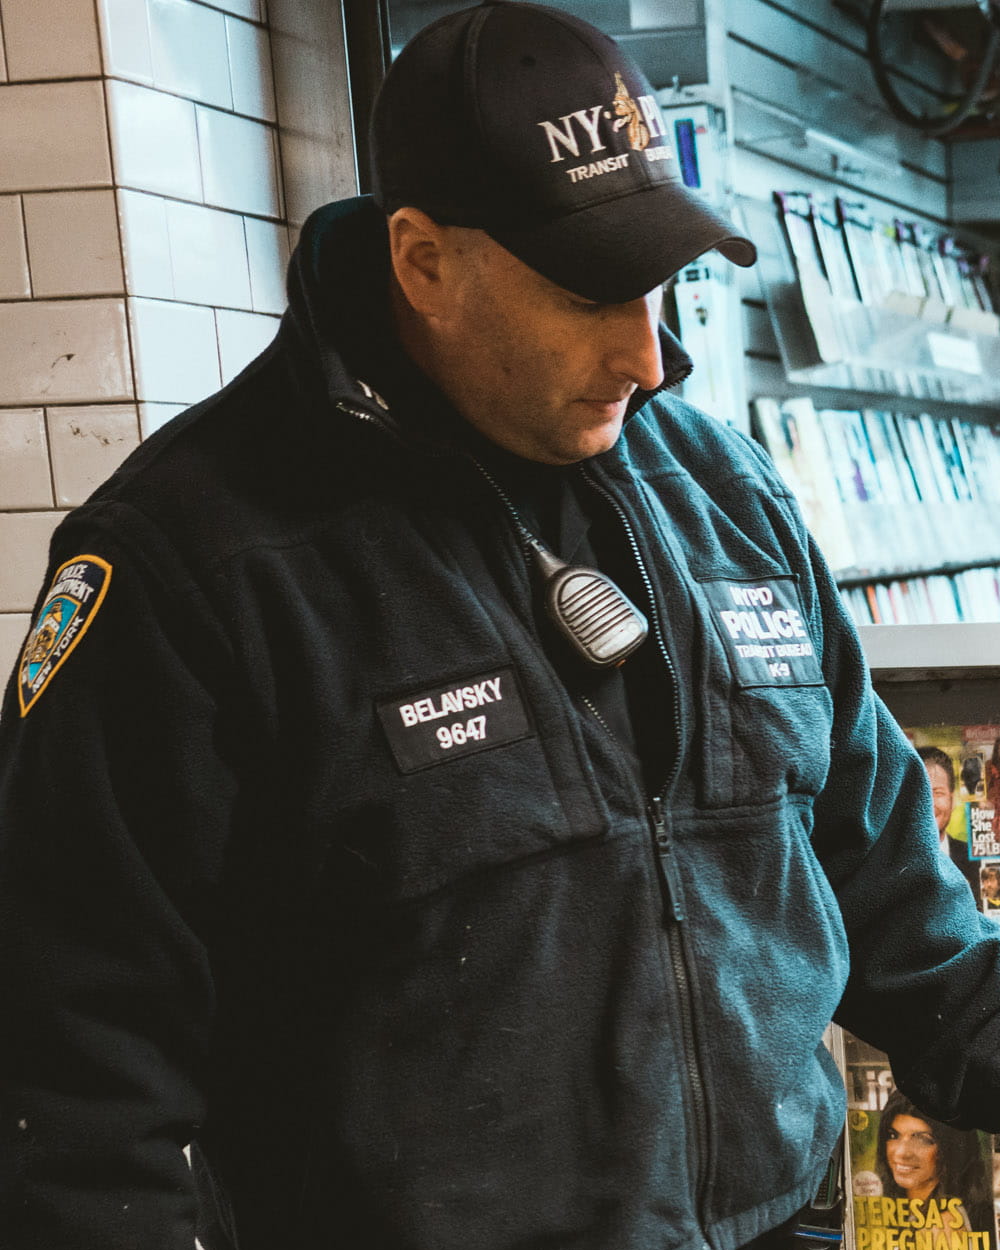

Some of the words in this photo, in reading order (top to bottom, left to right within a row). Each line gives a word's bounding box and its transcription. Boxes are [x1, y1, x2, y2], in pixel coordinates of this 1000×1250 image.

[565, 153, 629, 183] TRANSIT
[720, 609, 807, 639] POLICE
[399, 677, 503, 728] BELAVSKY
[436, 715, 487, 749] 9647
[971, 808, 995, 821] How
[971, 820, 992, 832] She
[854, 1197, 965, 1229] TERESA'S
